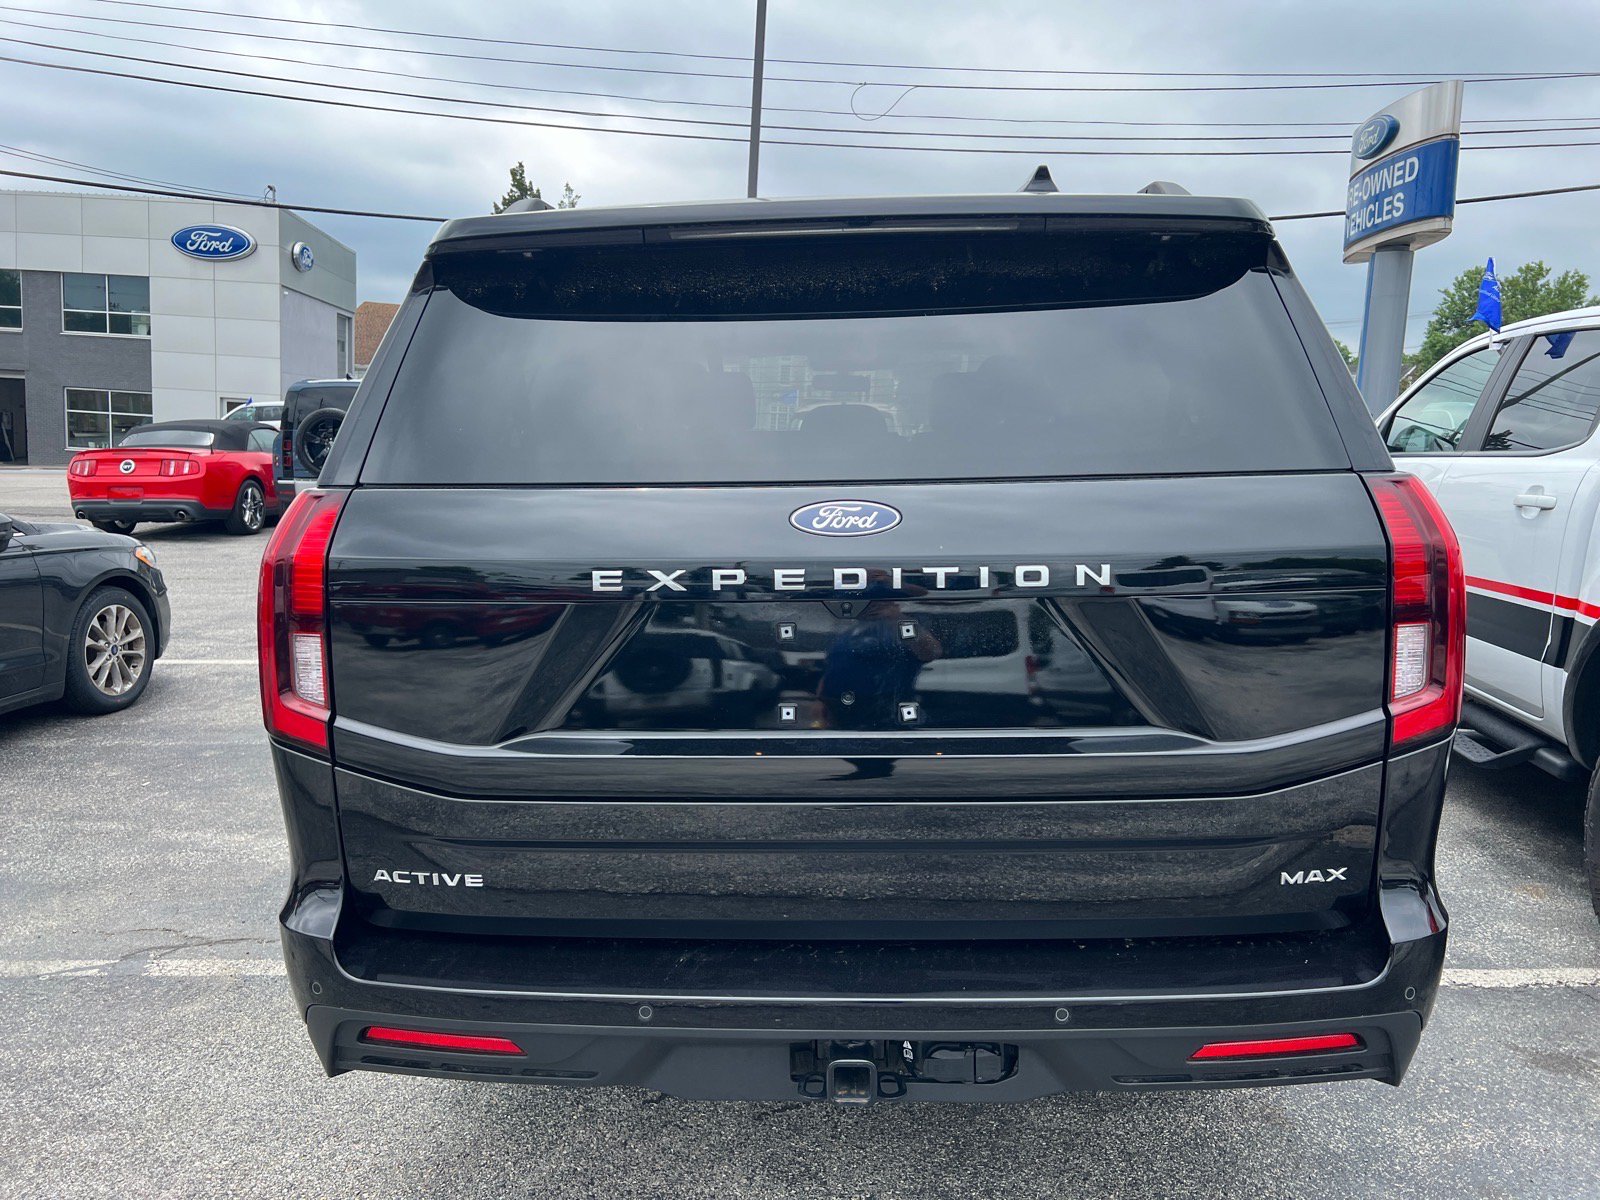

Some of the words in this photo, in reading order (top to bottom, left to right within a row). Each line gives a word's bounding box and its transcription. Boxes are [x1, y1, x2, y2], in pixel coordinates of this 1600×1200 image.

[1358, 125, 1380, 153] Ford
[1348, 156, 1419, 210] RE-OWNED
[186, 230, 234, 252] Ford
[812, 505, 879, 529] Ford
[591, 563, 1111, 592] EXPEDITION
[373, 869, 484, 887] ACTIVE
[1280, 866, 1348, 886] MAX
